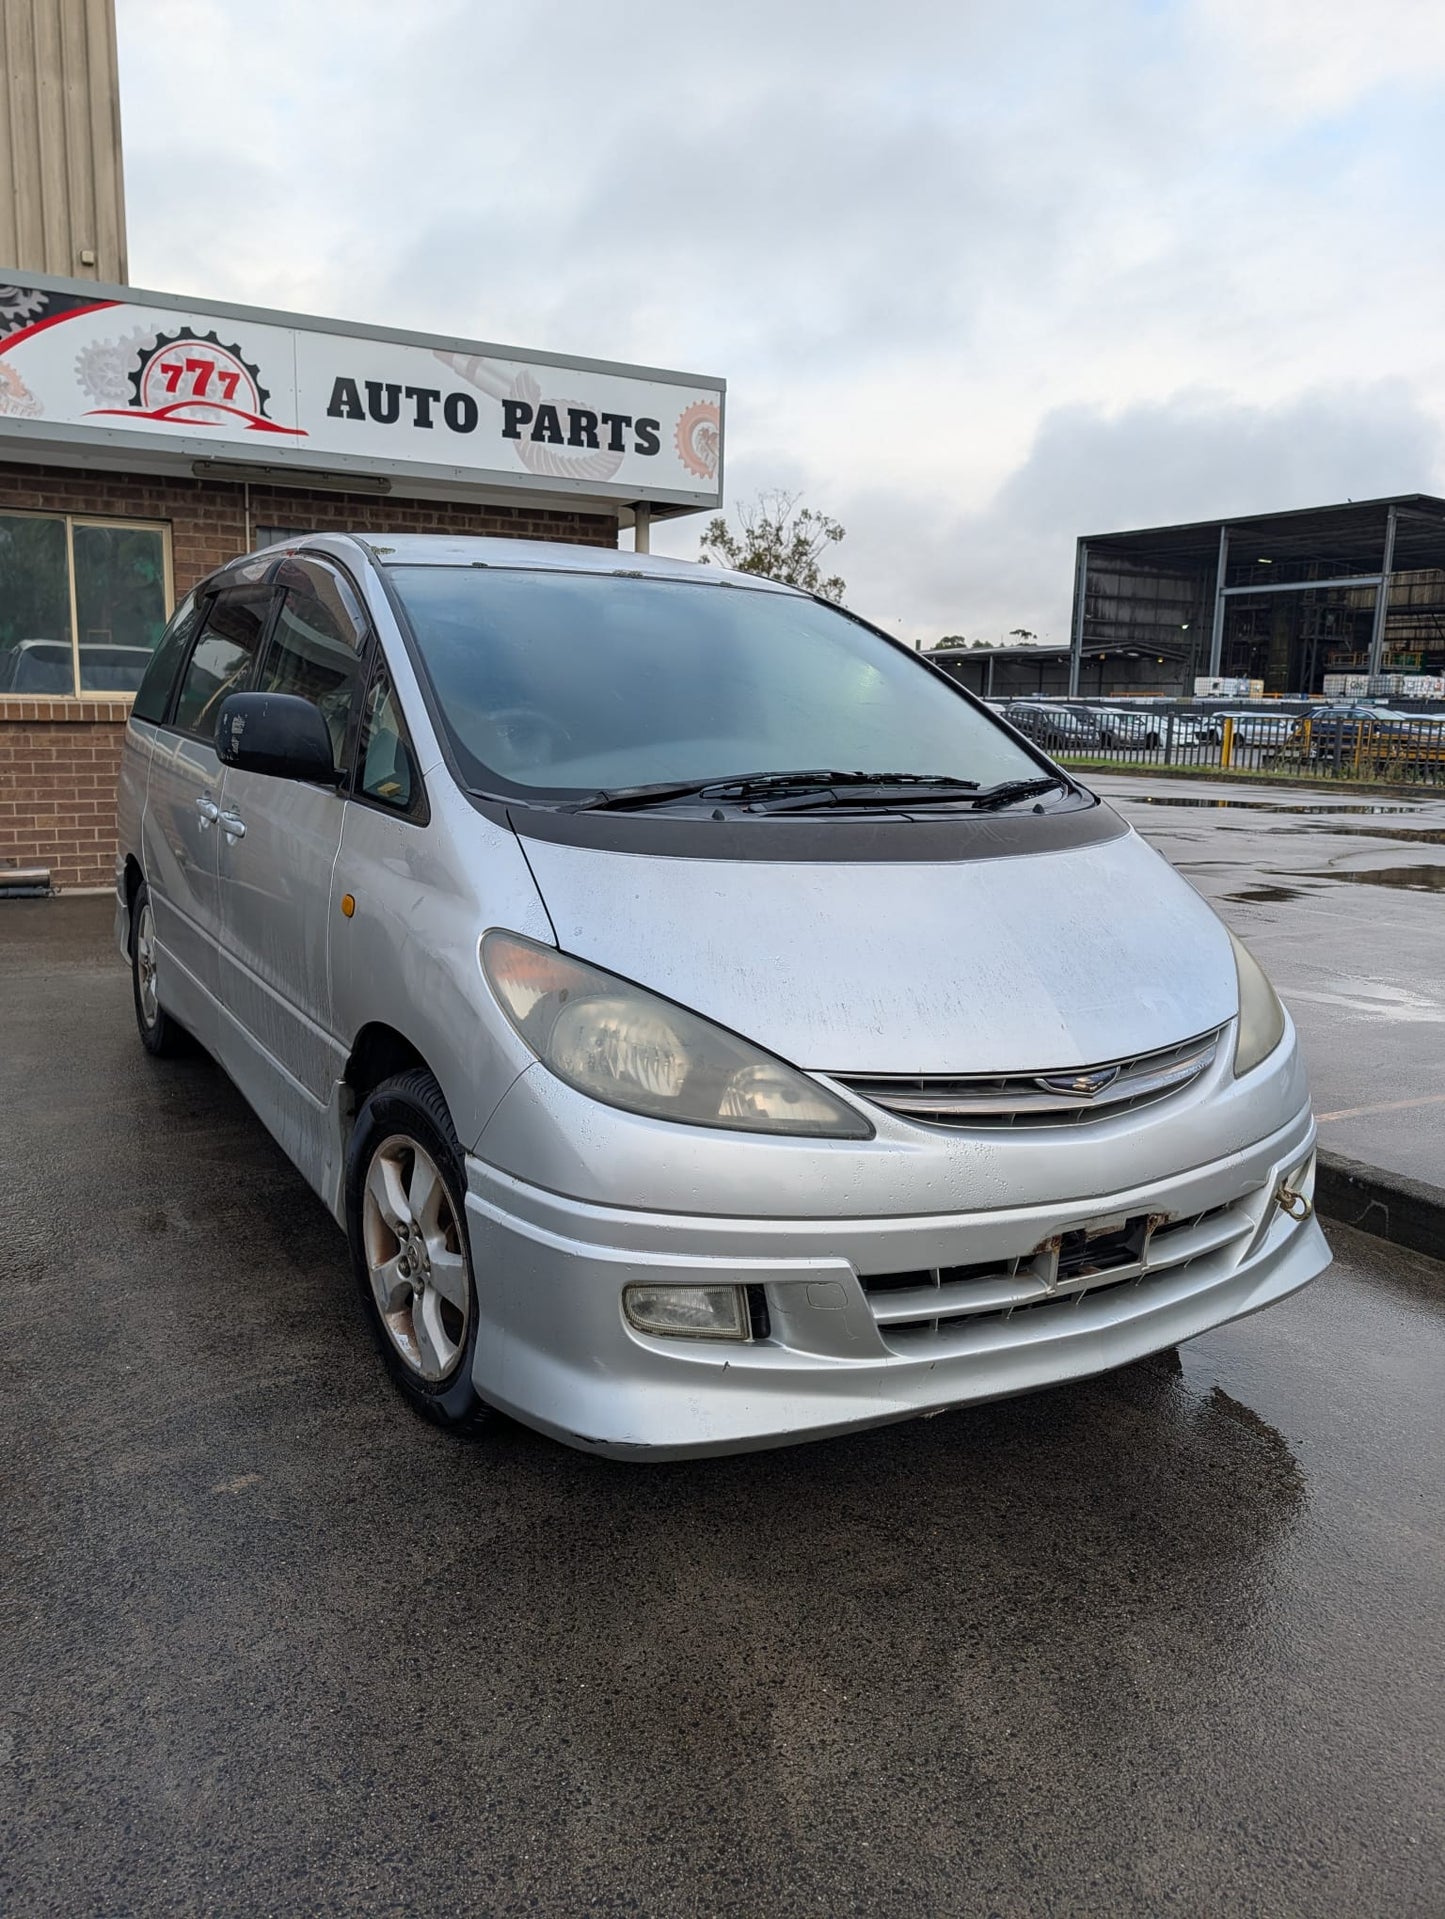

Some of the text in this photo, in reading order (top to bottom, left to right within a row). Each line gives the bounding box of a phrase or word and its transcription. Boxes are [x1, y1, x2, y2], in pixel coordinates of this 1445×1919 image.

[160, 358, 241, 401] 777
[326, 376, 662, 457] AUTO PARTS
